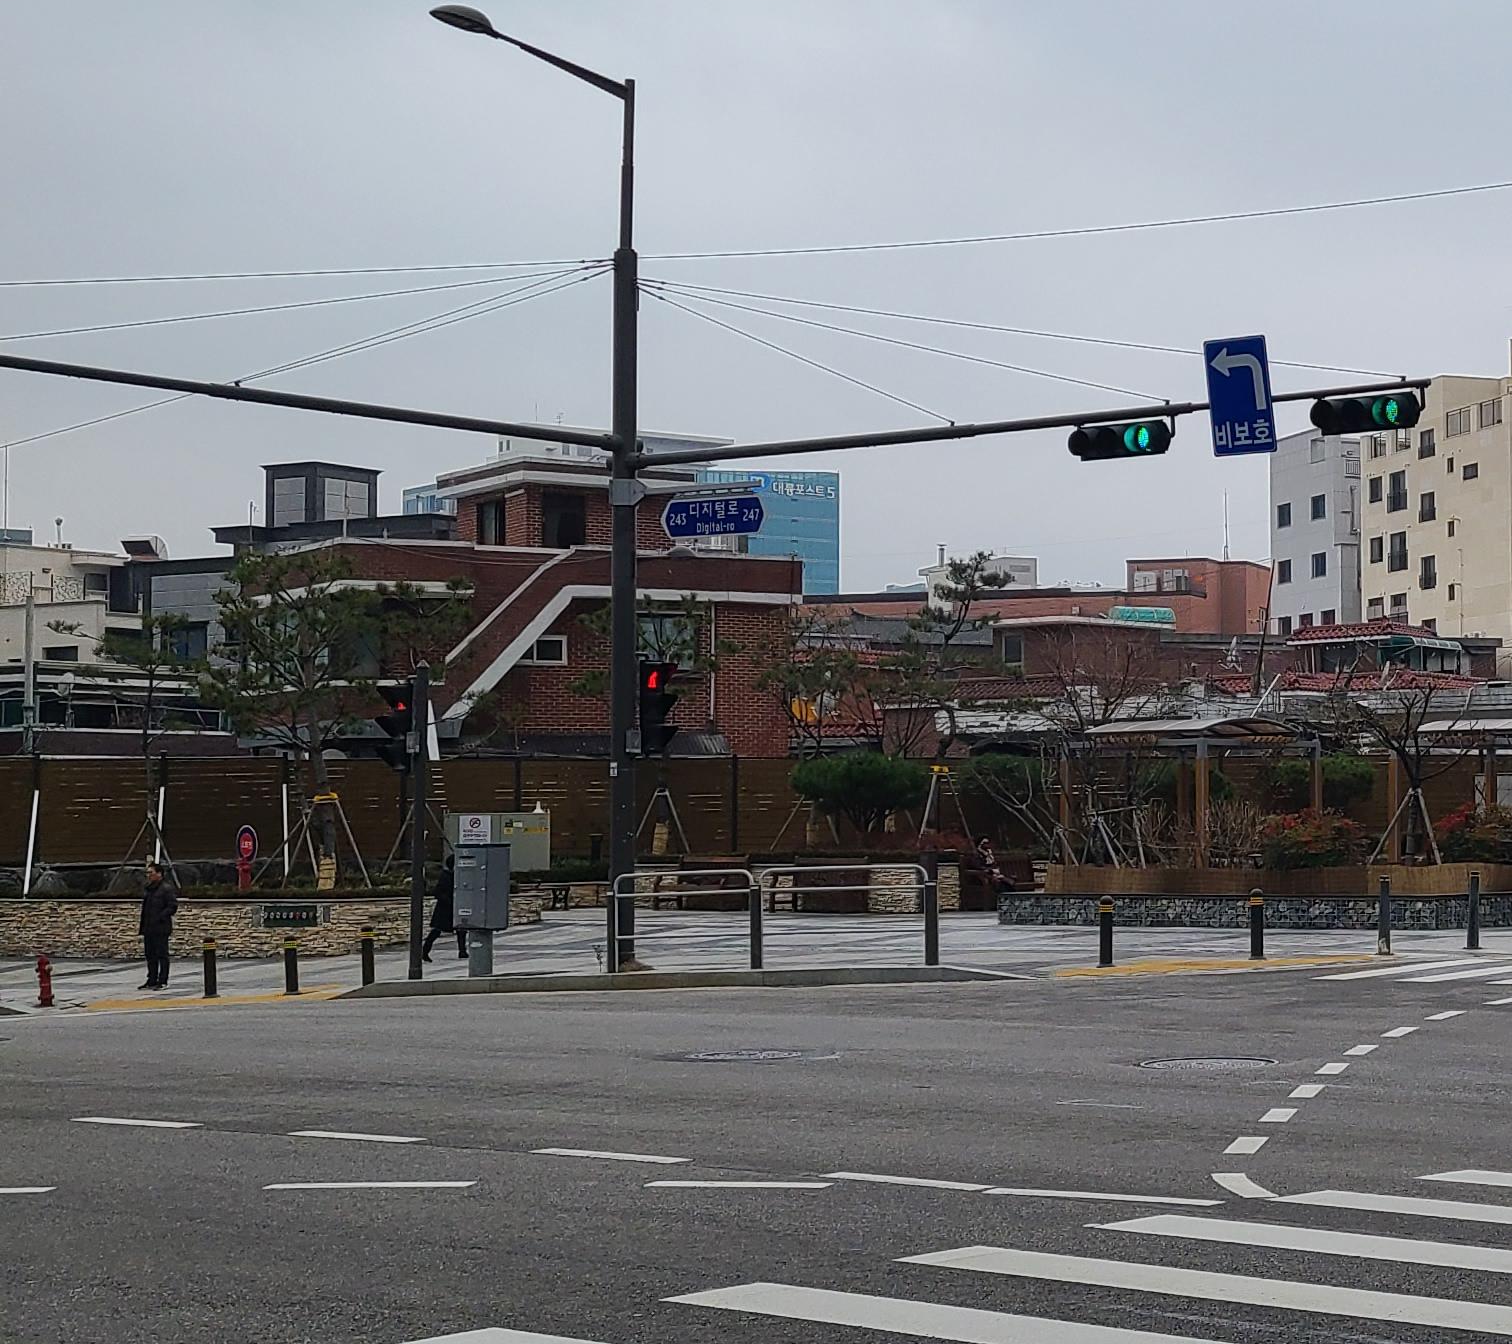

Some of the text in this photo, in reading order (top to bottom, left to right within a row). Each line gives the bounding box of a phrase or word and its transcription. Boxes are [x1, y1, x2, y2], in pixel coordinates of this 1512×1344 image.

[1215, 419, 1273, 448] 비보호
[669, 500, 760, 526] 243 디지털로 247
[696, 521, 735, 535] Digital-ro
